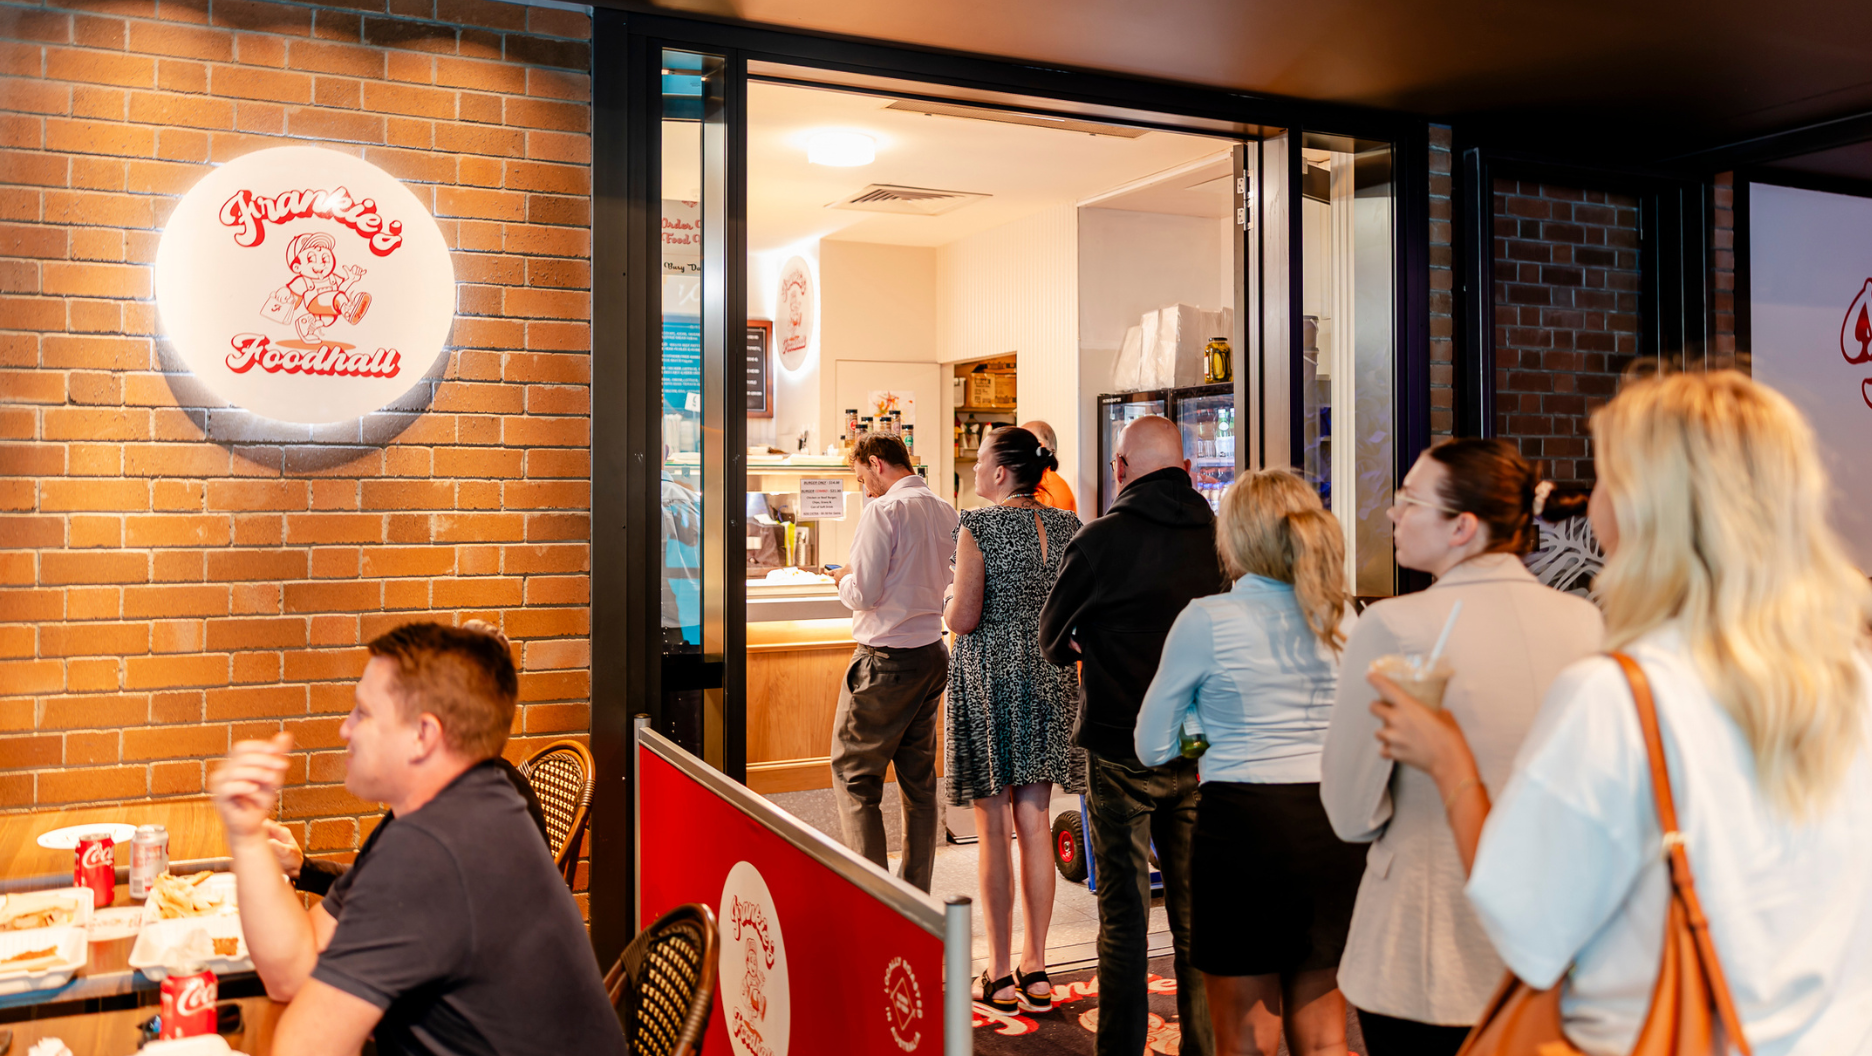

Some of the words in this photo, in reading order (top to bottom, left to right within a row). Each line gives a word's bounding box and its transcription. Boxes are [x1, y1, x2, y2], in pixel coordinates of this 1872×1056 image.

[219, 186, 403, 257] Frankie's
[225, 332, 402, 378] Foodhall
[730, 894, 775, 970] Frankie's
